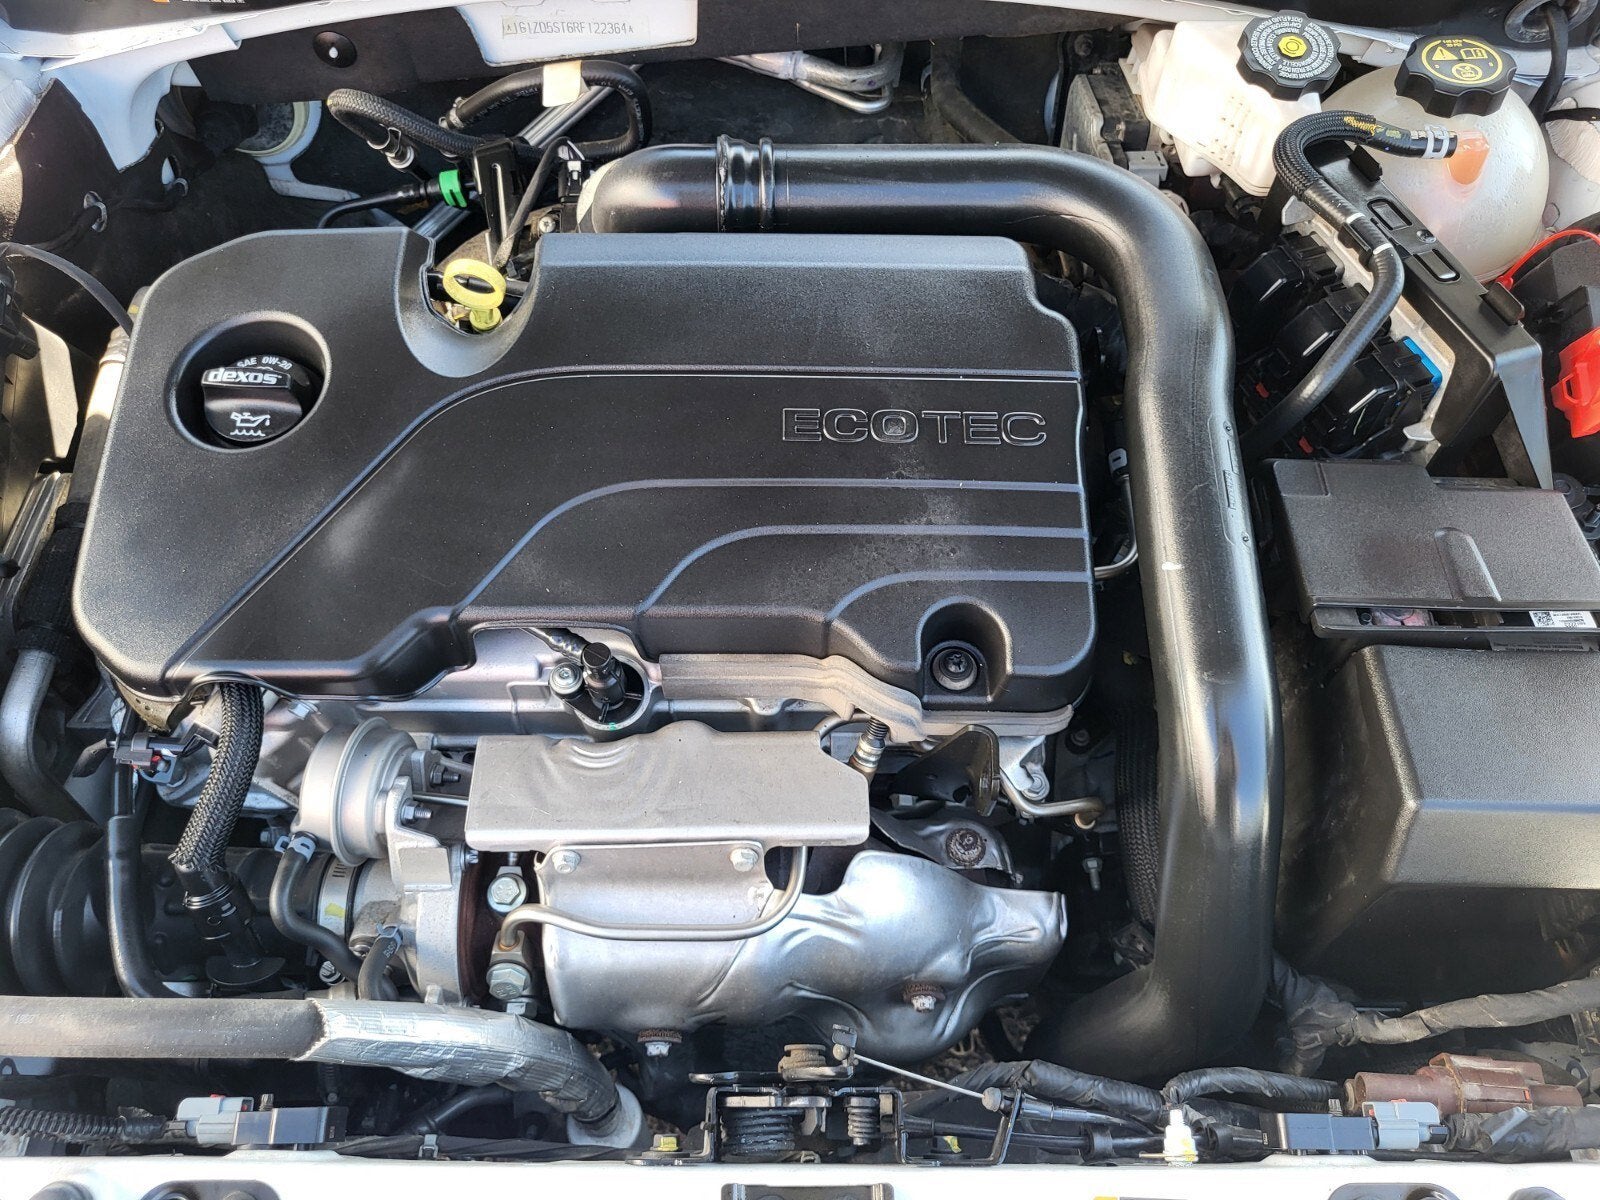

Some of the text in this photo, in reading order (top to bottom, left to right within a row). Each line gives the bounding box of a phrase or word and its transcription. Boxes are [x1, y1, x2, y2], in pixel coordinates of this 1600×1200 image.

[237, 357, 258, 368] SAE
[208, 368, 278, 385] dexos
[783, 408, 1047, 446] ECOTEC
